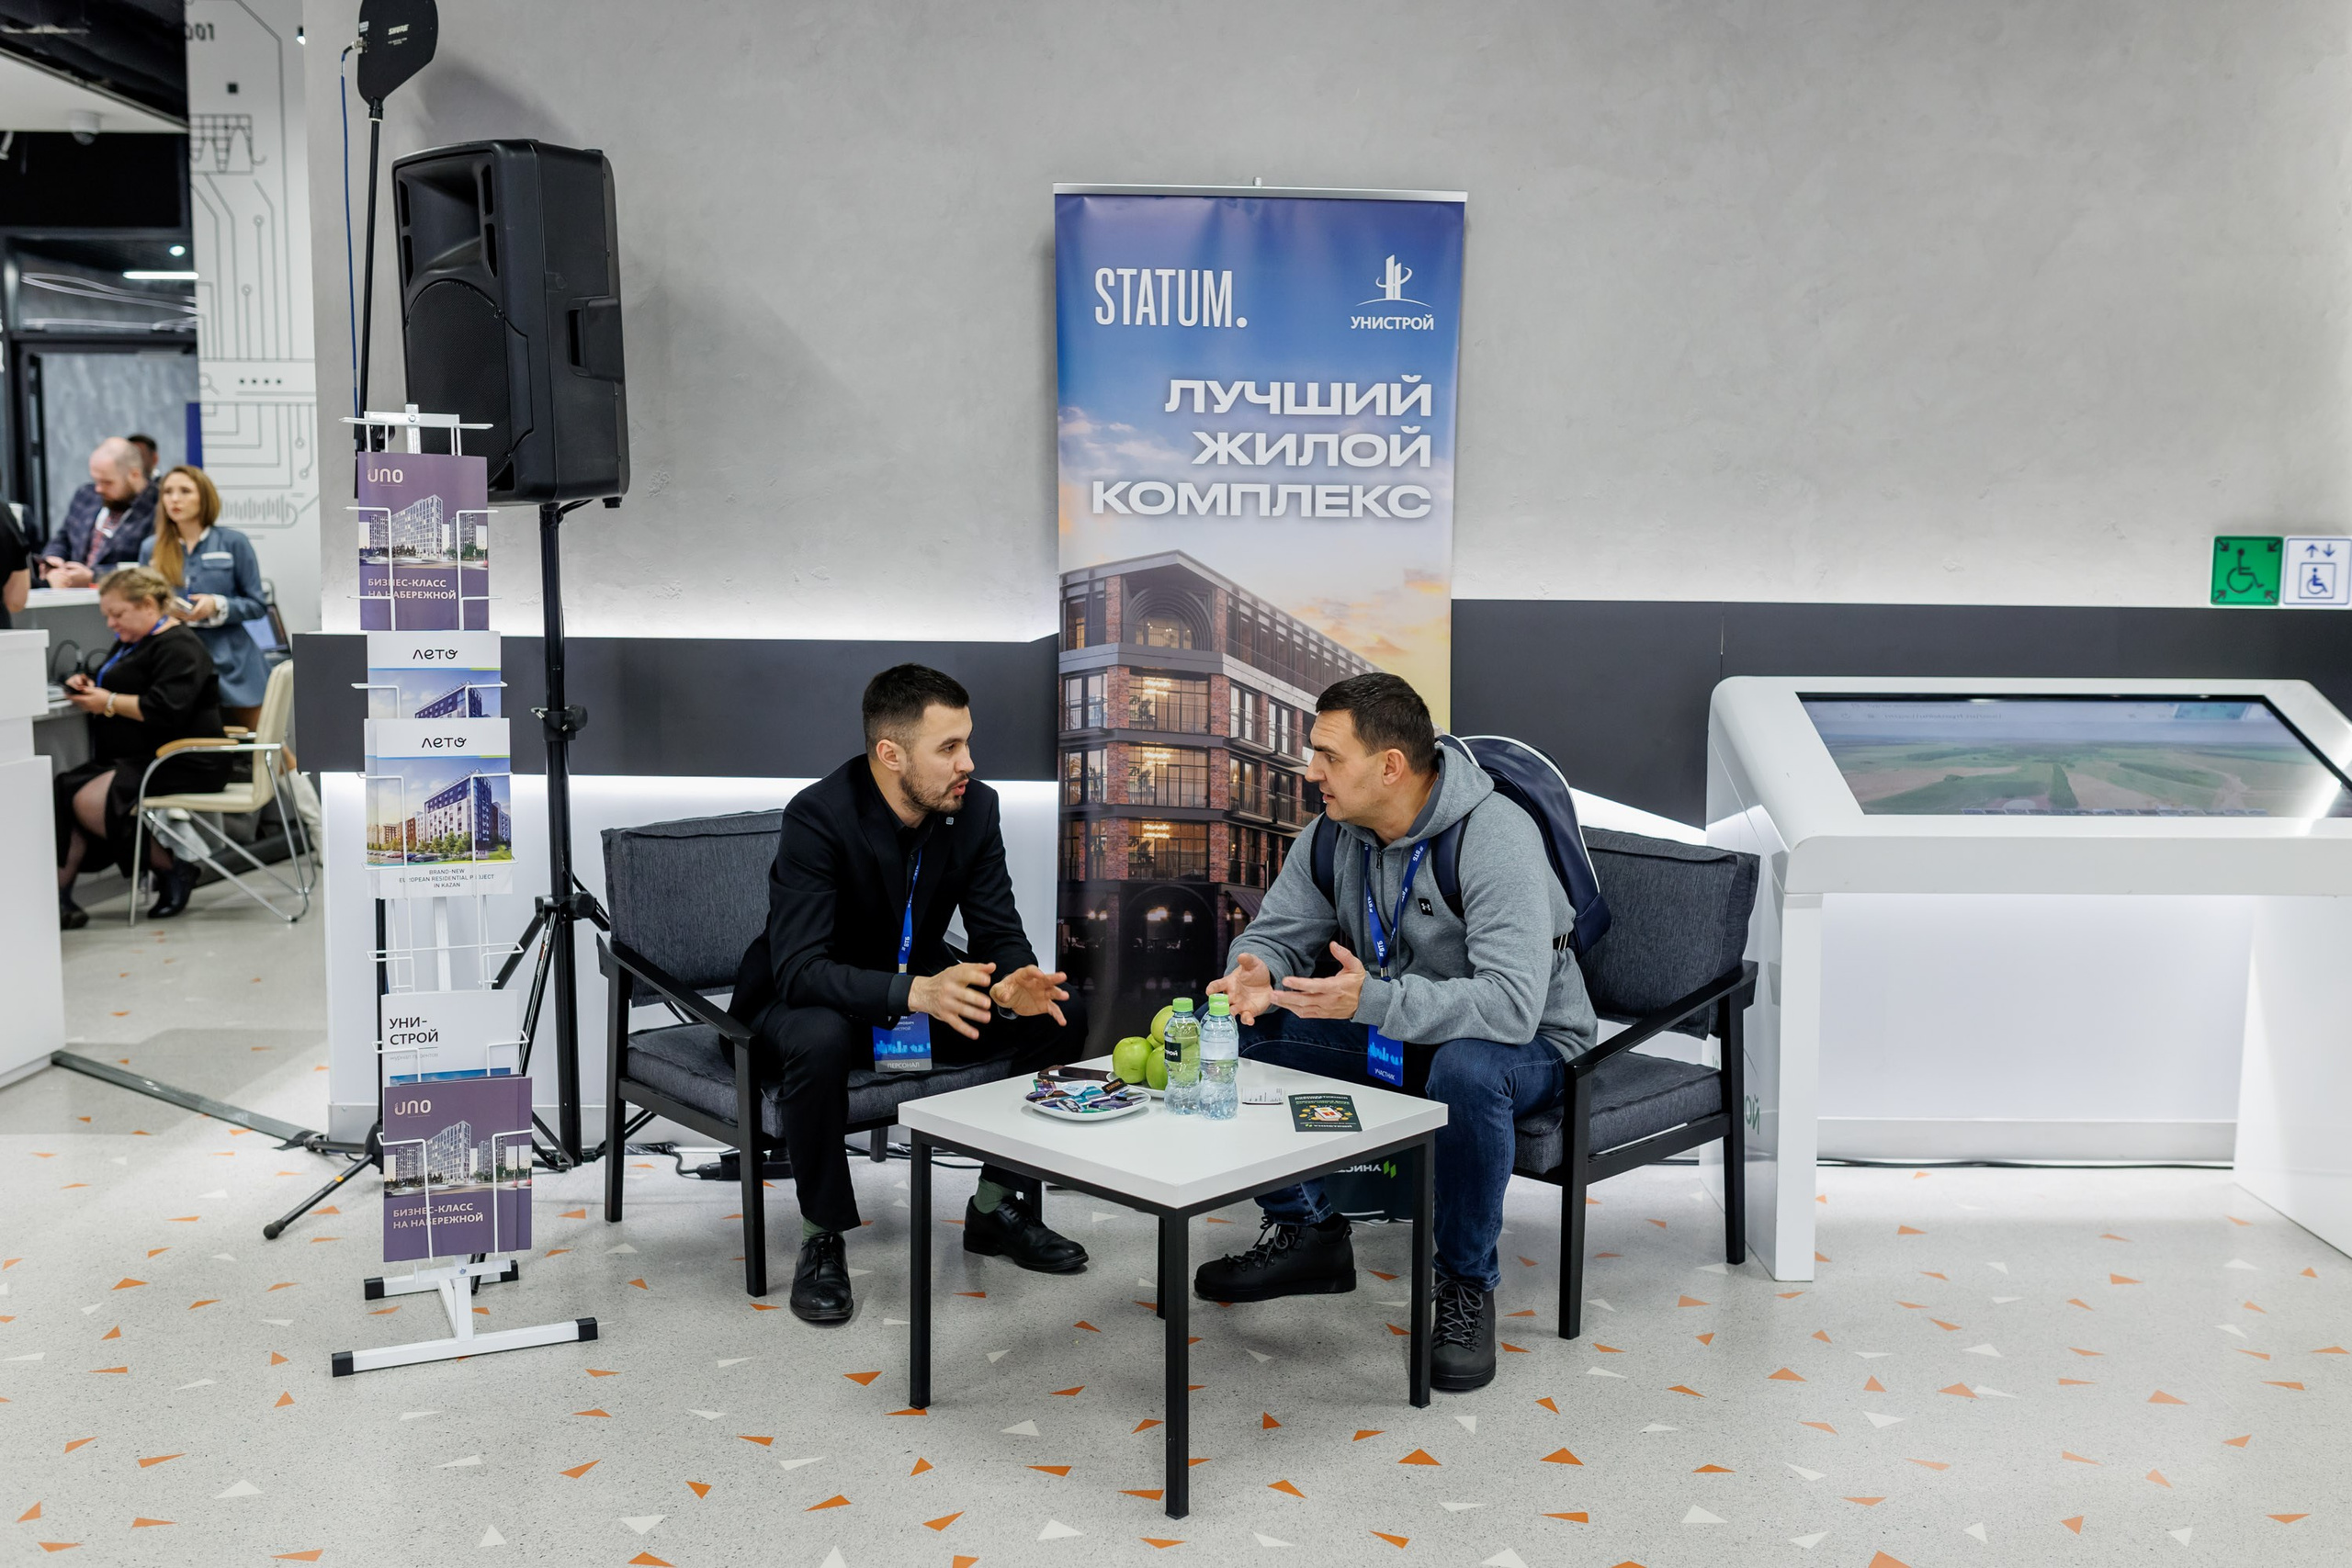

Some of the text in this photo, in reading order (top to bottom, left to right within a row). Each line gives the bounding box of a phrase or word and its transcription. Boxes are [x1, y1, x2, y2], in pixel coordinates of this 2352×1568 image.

[1094, 267, 1248, 328] STATUM.
[1351, 313, 1434, 331] УНИСТРОЙ
[1164, 374, 1431, 416] ЛУЧШИЙ
[1191, 425, 1431, 468] ЖИЛОЙ
[1092, 480, 1431, 519] КОМПЛЕКС
[389, 1016, 427, 1030] УНИ-
[390, 1028, 438, 1045] СТРОЙ
[887, 1061, 920, 1069] ПЕРСОНАЛ
[1334, 1164, 1382, 1174] УНИС
[393, 1202, 474, 1218] БИЗНЕС-КЛАСС
[393, 1221, 409, 1230] НА
